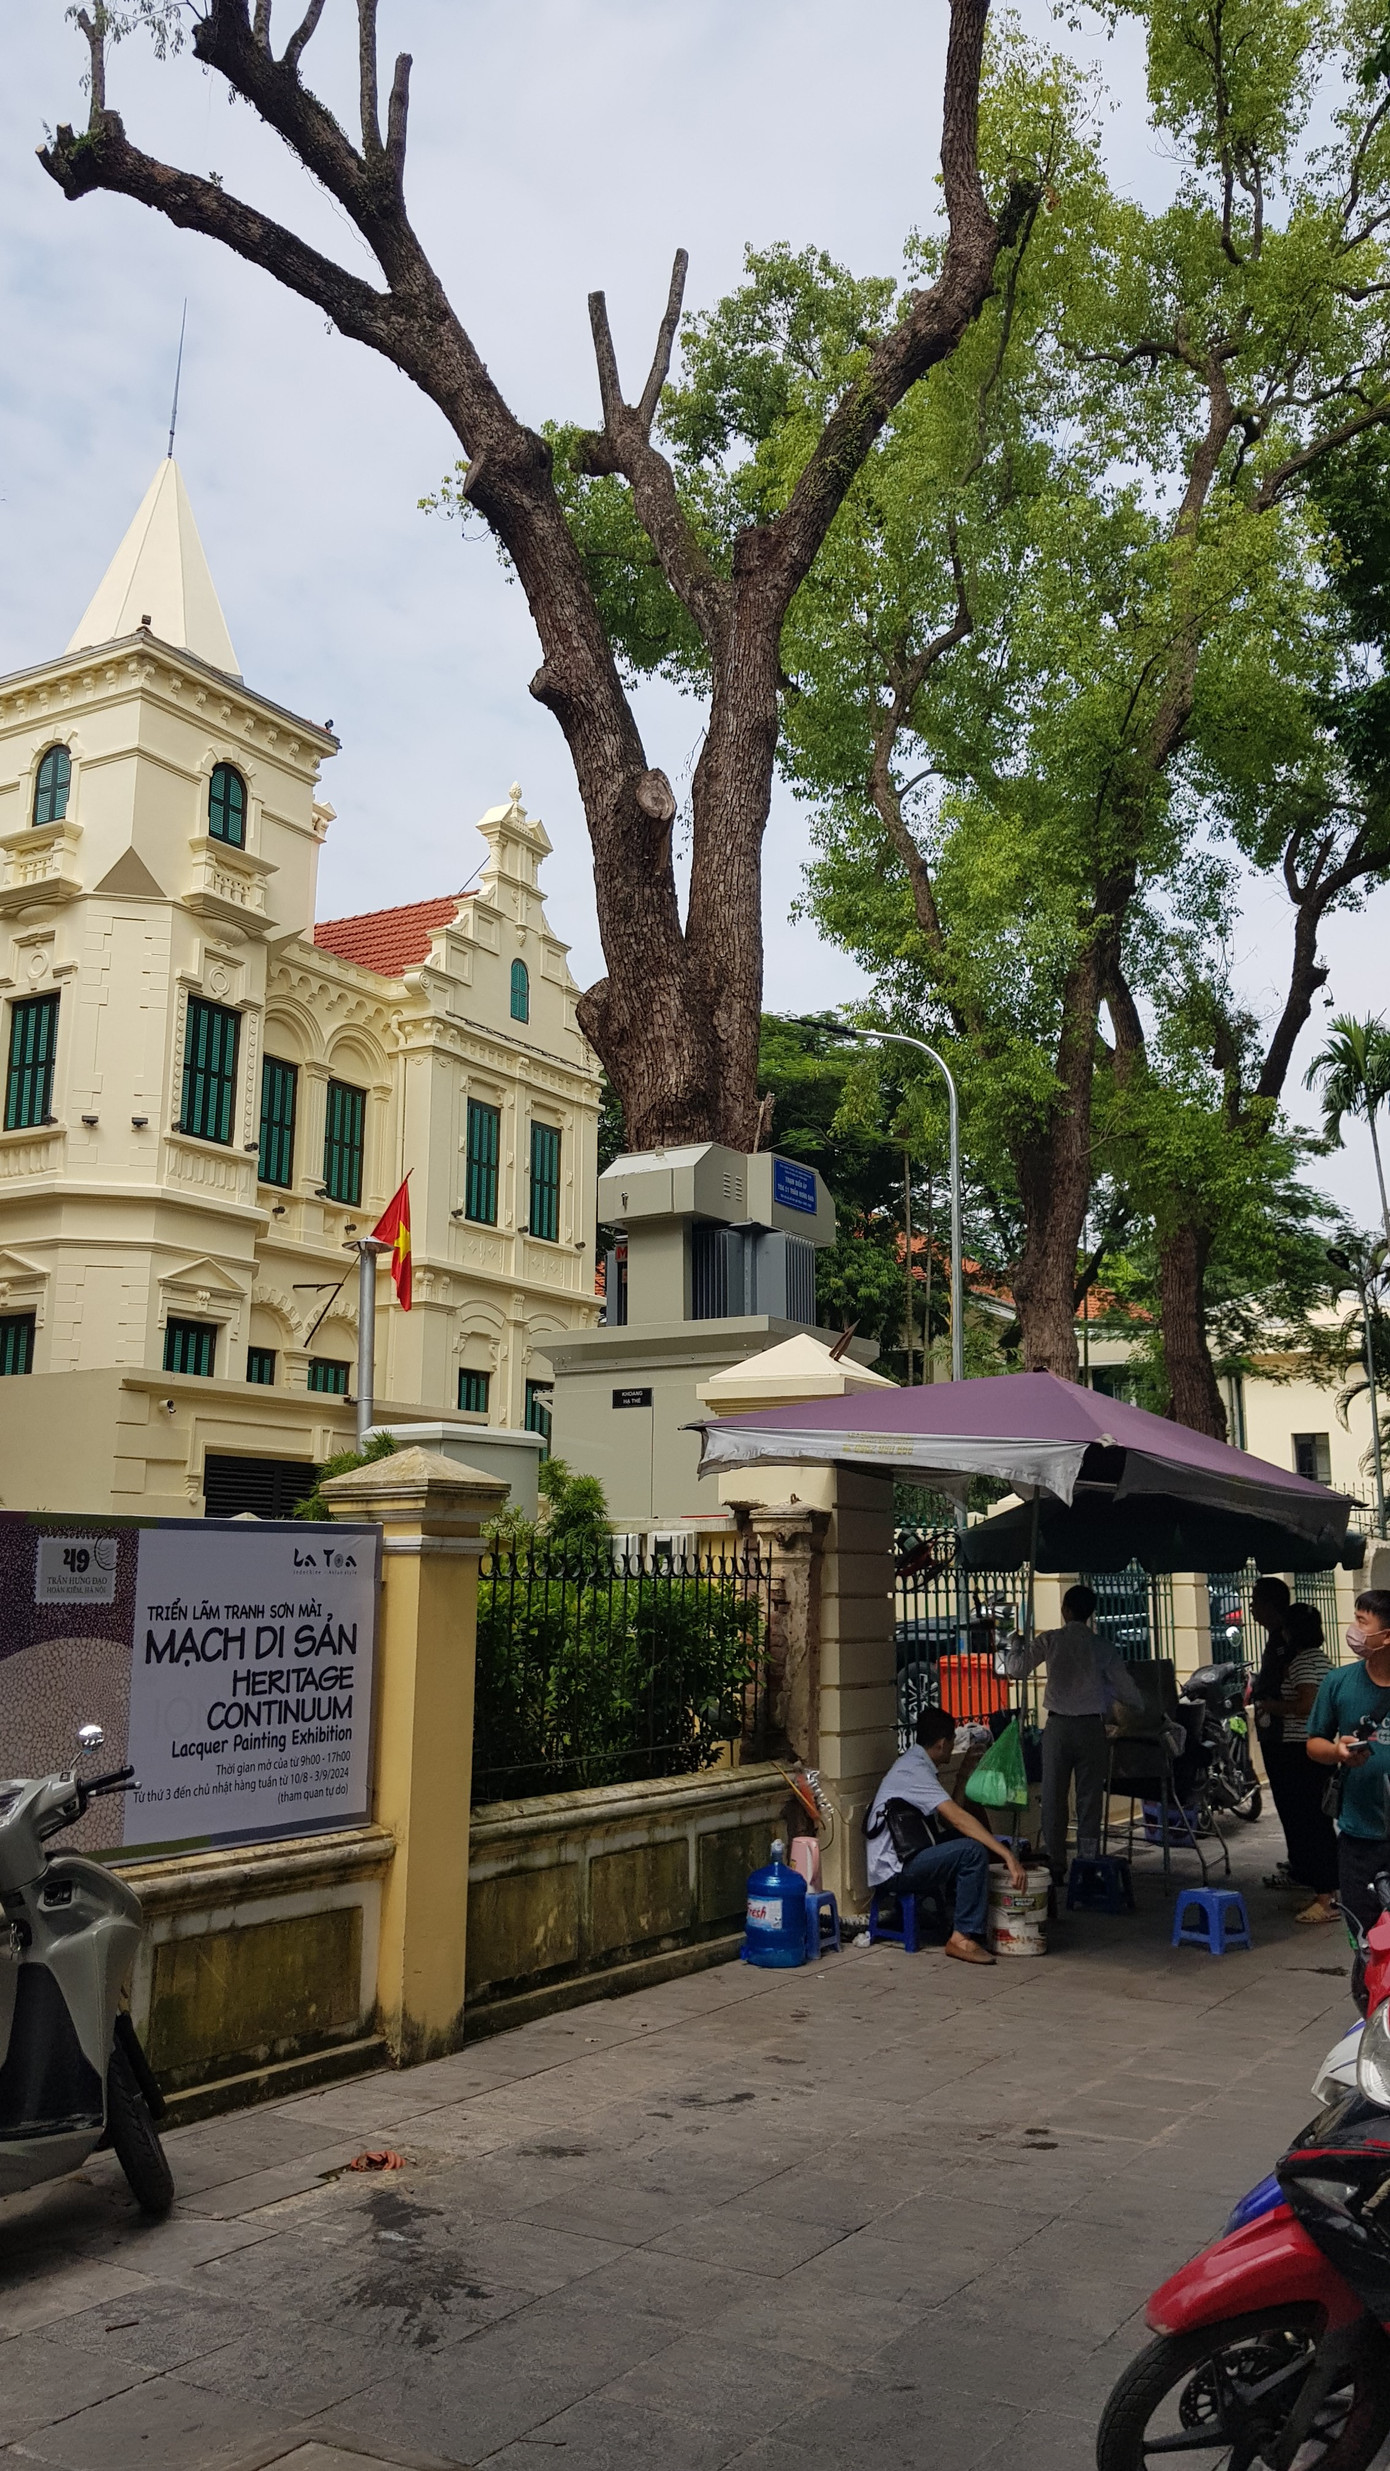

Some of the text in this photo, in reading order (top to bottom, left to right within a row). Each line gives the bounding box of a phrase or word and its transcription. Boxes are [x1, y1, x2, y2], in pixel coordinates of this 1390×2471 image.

[63, 1548, 90, 1573] 49
[48, 1575, 108, 1586] TRẦN HƯNG ĐẠO
[147, 1598, 322, 1621] TRIỂN LÃM TRANH SƠN MÀI
[145, 1613, 357, 1667] MẠCH DI SẢN
[232, 1666, 354, 1697] HERITAGE
[206, 1694, 353, 1730] CONTINUUM
[172, 1724, 352, 1761] Lacquer Painting Exhibition
[216, 1762, 235, 1776] Thời
[237, 1762, 256, 1776] gian
[290, 1756, 300, 1767] từ
[300, 1754, 321, 1766] 9h00
[327, 1750, 351, 1763] 17h00
[133, 1790, 146, 1803] Từ
[147, 1788, 164, 1802] thứ
[166, 1788, 171, 1800] 3
[174, 1785, 191, 1800] đến
[193, 1783, 210, 1796] chủ
[212, 1780, 232, 1795] nhật
[234, 1780, 256, 1792] hàng
[291, 1772, 308, 1784] 10/8
[314, 1767, 349, 1782] 3/9/2024
[277, 1791, 302, 1805] (tham
[304, 1789, 324, 1801] quan
[336, 1784, 349, 1795] do)
